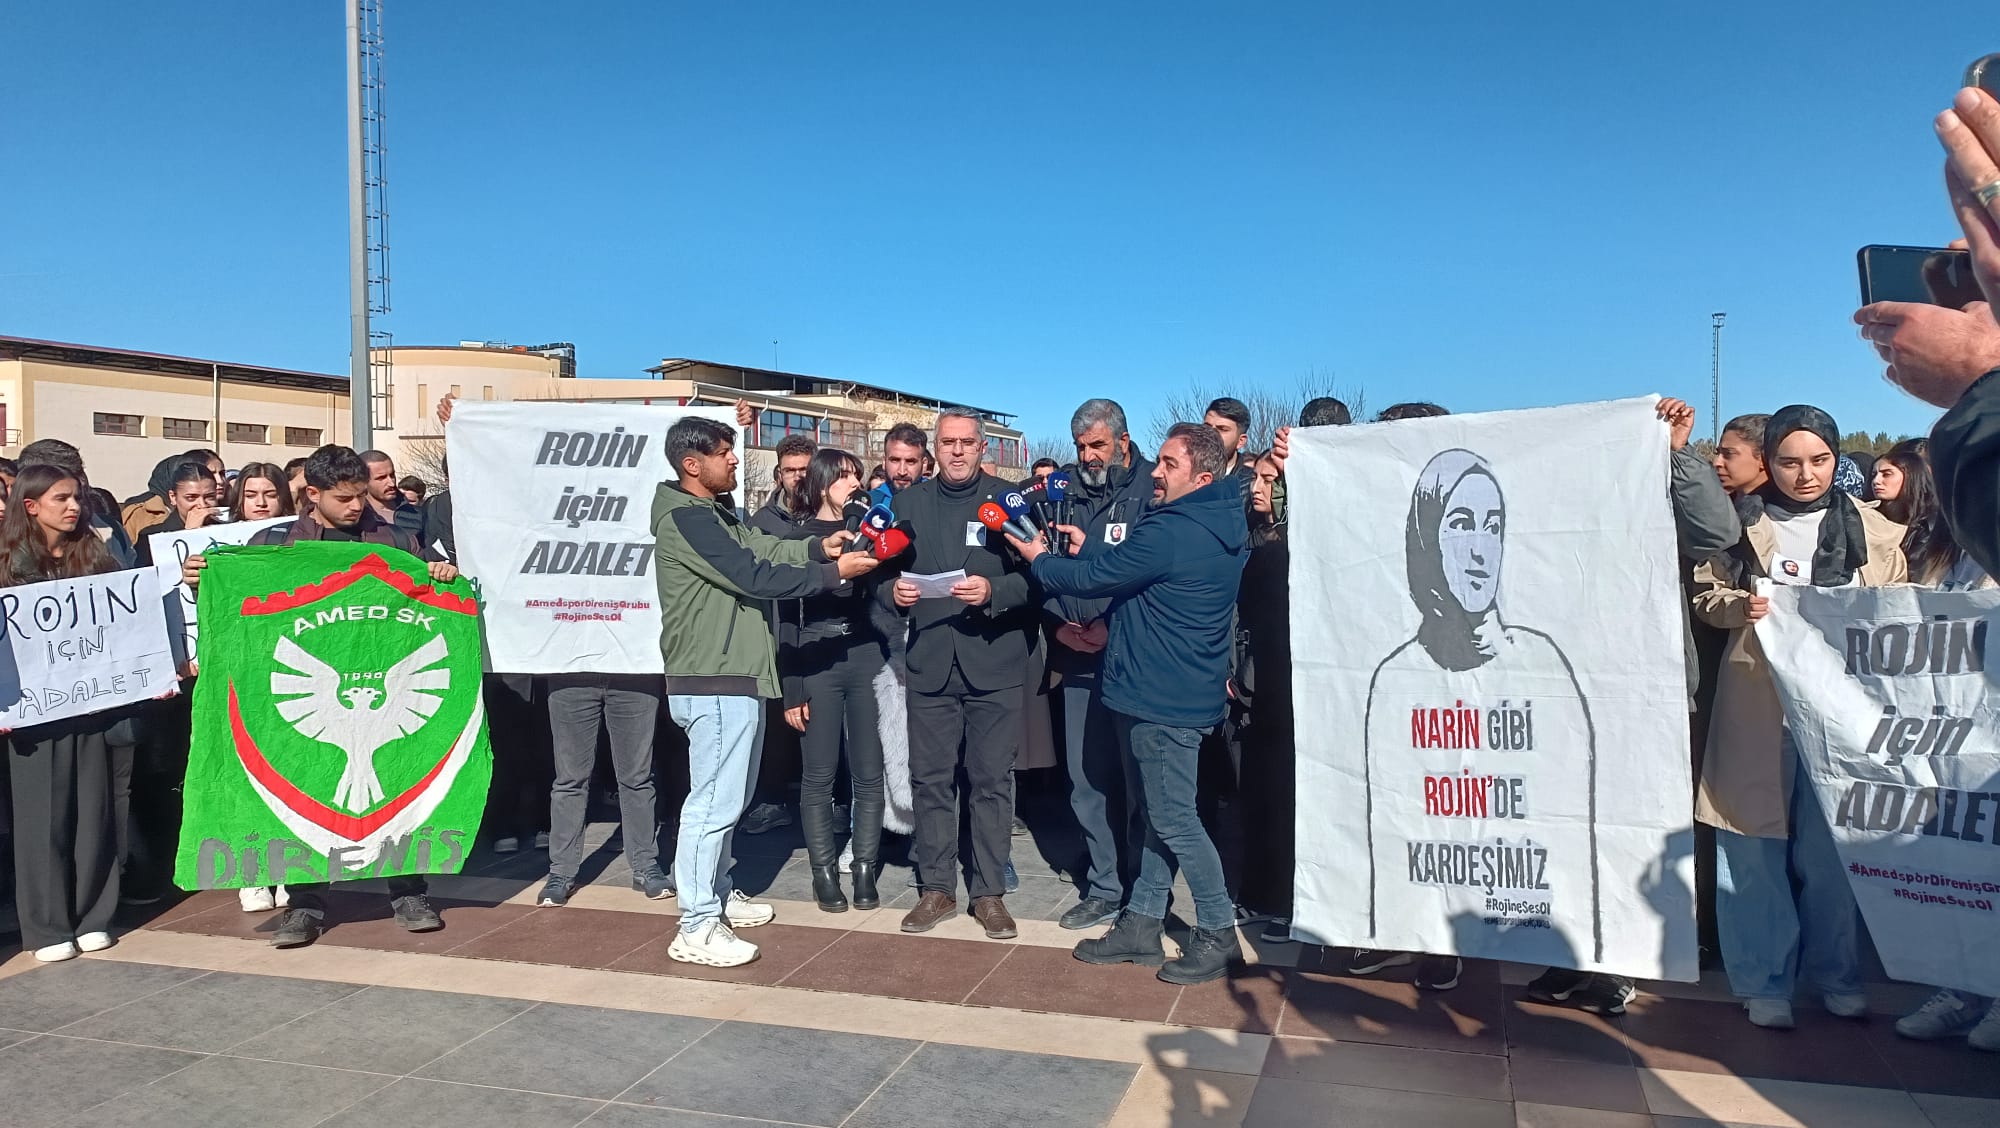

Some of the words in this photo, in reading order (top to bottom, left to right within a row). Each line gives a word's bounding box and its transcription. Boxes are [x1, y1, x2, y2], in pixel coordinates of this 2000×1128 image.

[536, 427, 649, 468] ROJİN
[553, 486, 628, 528] için
[519, 541, 656, 576] ADALET
[294, 606, 389, 636] AMED
[395, 608, 435, 632] SK
[1844, 615, 1988, 676] ROJİN
[20, 668, 151, 719] ADALET
[1411, 700, 1480, 749] NARİN
[1487, 700, 1533, 750] GİBİ
[1865, 705, 1973, 766] için
[1407, 837, 1550, 895] KARDEŞİMİZ
